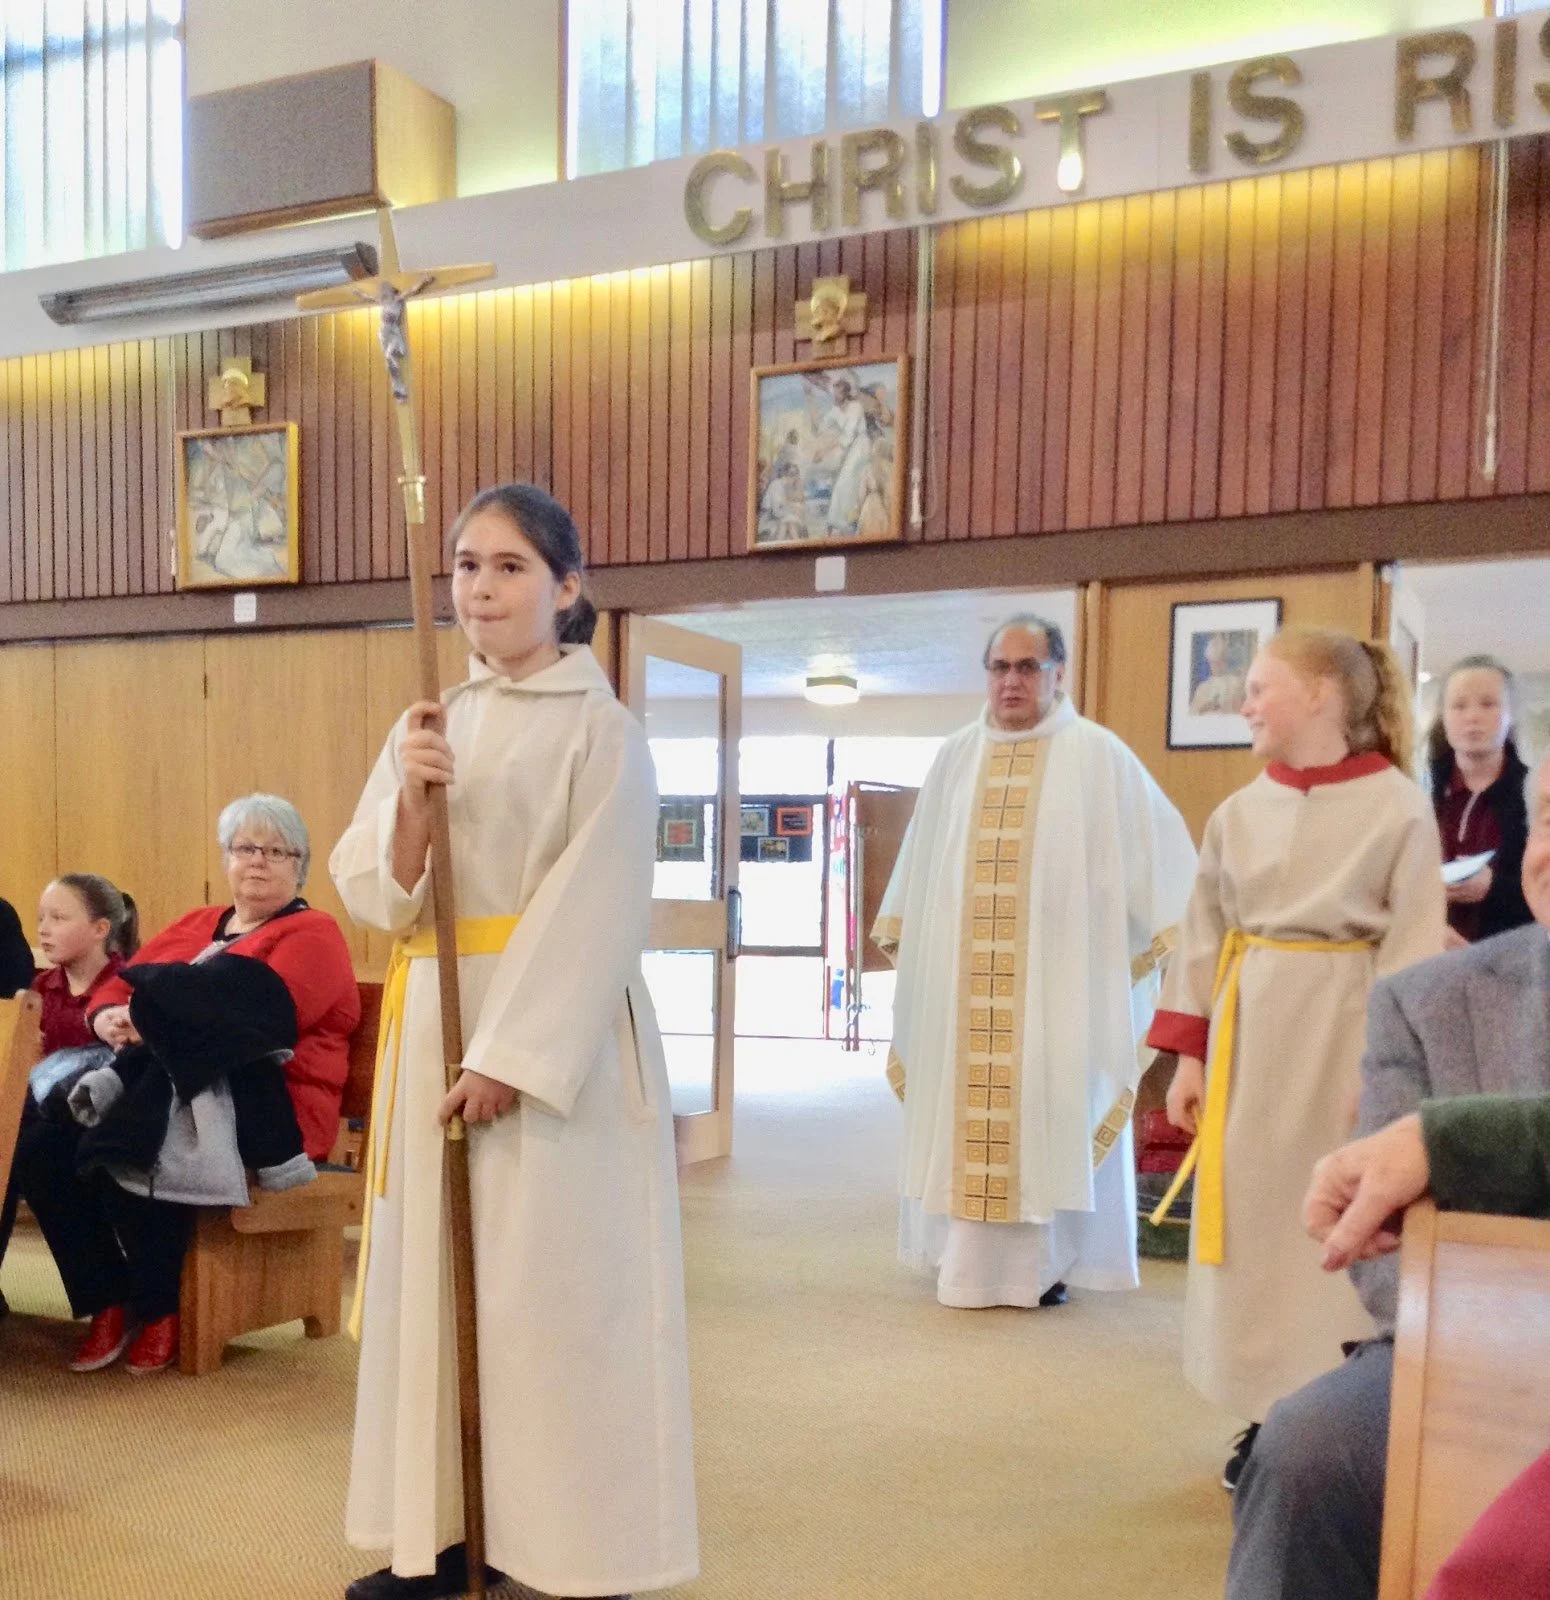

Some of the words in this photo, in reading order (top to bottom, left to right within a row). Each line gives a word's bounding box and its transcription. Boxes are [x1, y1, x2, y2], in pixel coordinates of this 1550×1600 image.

[684, 89, 1109, 246] CHRIST
[1186, 56, 1306, 176] IS
[1394, 13, 1550, 143] RI
